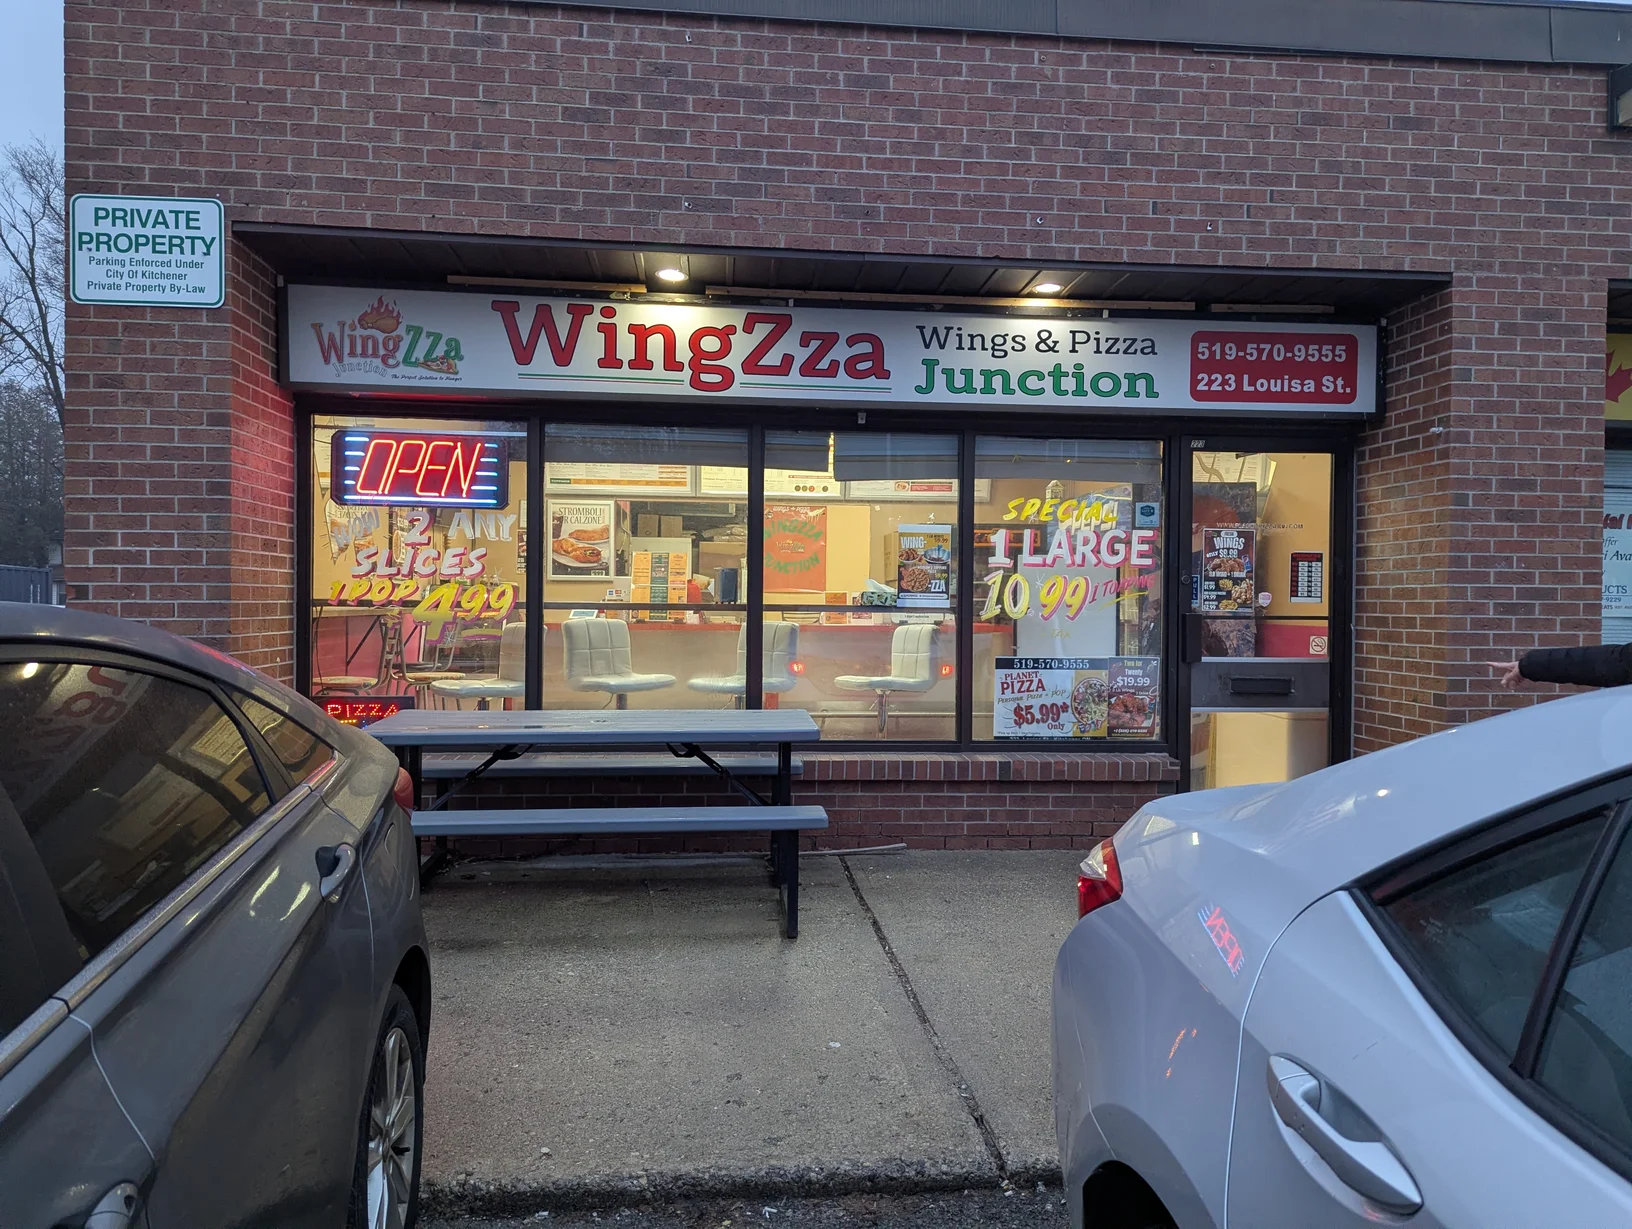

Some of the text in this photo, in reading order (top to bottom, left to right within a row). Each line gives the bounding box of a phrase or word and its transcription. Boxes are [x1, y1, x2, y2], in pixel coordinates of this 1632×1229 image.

[94, 206, 201, 231] PRIVATE
[78, 231, 216, 256] PROPERTY
[88, 256, 205, 269] Parking Enforced Under
[105, 268, 188, 281] City Of Kitchener
[87, 281, 206, 294] Private Property By-Law
[311, 320, 465, 369] WingZza
[491, 300, 891, 392] WingZza
[915, 324, 1158, 358] Wings & Pizza
[1197, 341, 1347, 364] 519-570-9555
[332, 360, 388, 378] Junction
[914, 358, 1160, 399] Junction
[1196, 372, 1352, 394] 223 Louisa St.
[356, 438, 482, 498] OPEN
[558, 507, 602, 516] STROMBOLI
[569, 516, 603, 524] CALZONE
[1002, 497, 1119, 523] SPECIAL
[404, 510, 434, 547] 2
[447, 511, 518, 541] ANY
[988, 528, 1159, 569] 1 LARGE
[1213, 536, 1245, 550] WINGS
[351, 546, 487, 579] SLICES
[346, 579, 420, 607] POP
[1013, 658, 1090, 670] 519-570-9555
[1000, 678, 1046, 695] PIZZA
[1004, 671, 1040, 681] PLANET
[1116, 676, 1150, 686] $19.99
[327, 703, 398, 718] PIZZA
[1047, 722, 1066, 731] Only
